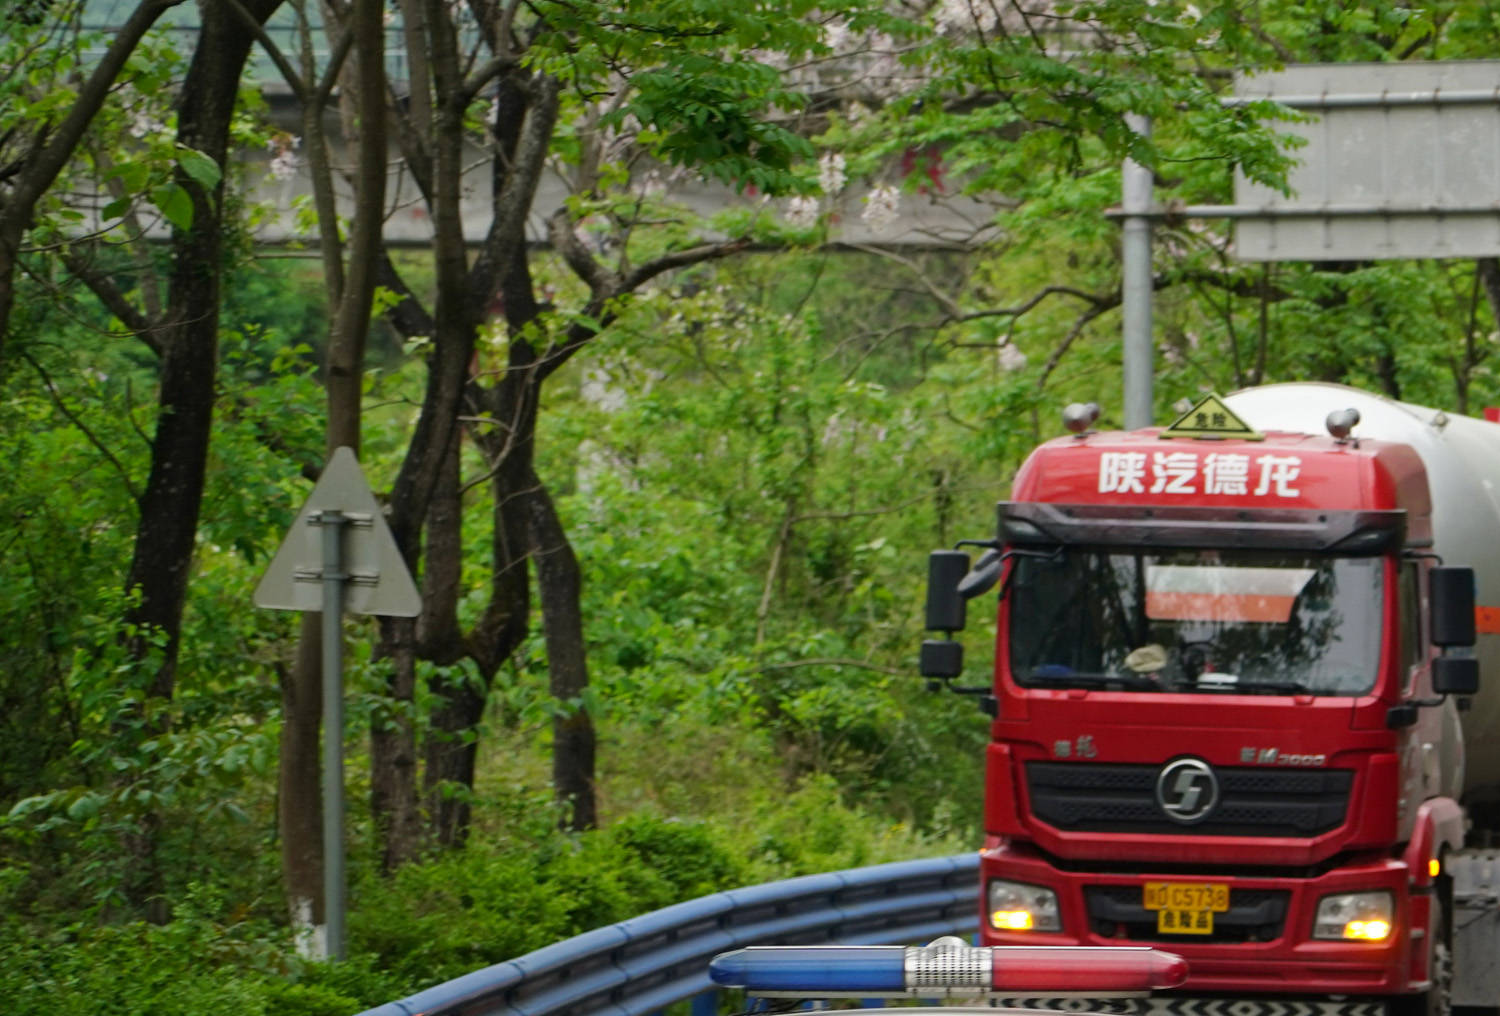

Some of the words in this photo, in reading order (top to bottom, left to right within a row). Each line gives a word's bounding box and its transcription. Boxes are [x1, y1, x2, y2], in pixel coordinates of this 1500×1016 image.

[1195, 411, 1227, 428] 危险
[1097, 451, 1303, 498] 陕汽德龙
[1163, 910, 1209, 929] 危险品
